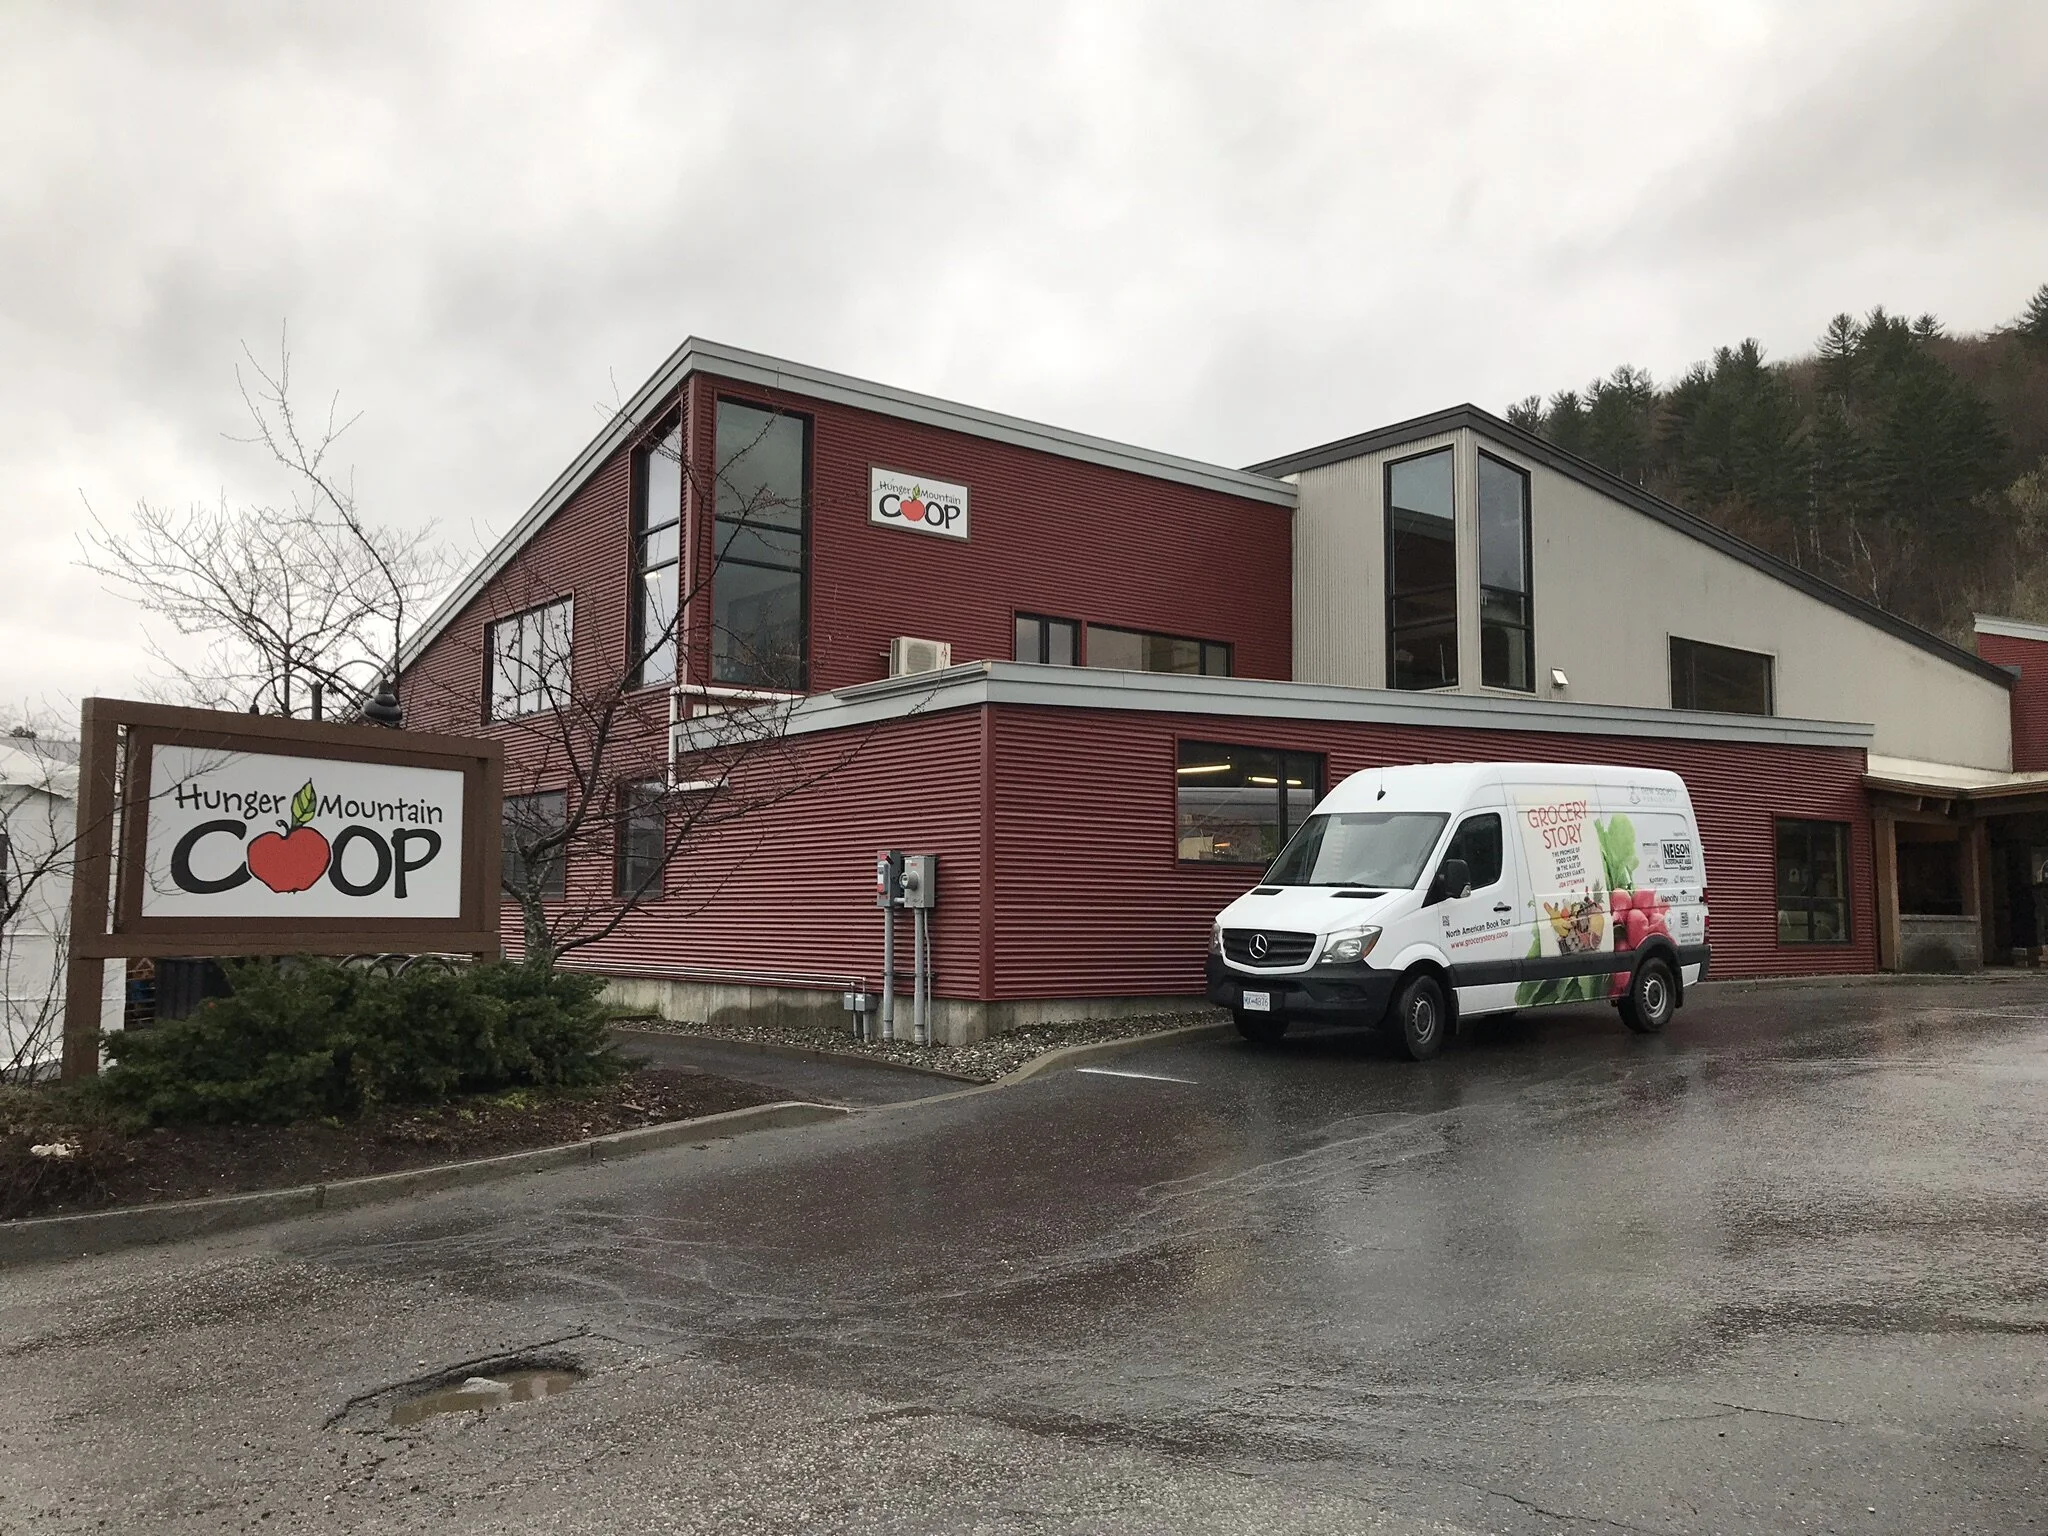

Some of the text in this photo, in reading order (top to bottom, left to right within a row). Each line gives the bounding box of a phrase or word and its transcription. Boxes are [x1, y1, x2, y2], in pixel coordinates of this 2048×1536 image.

[879, 481, 961, 505] Hunger Mountain
[175, 782, 442, 824] Hunger Mountain
[1527, 800, 1587, 828] GROCERY
[1542, 823, 1582, 849] STORY
[1663, 843, 1690, 858] NELSON
[1445, 918, 1511, 938] North American Book Tour
[1450, 931, 1509, 949] www.grocerystory.coop
